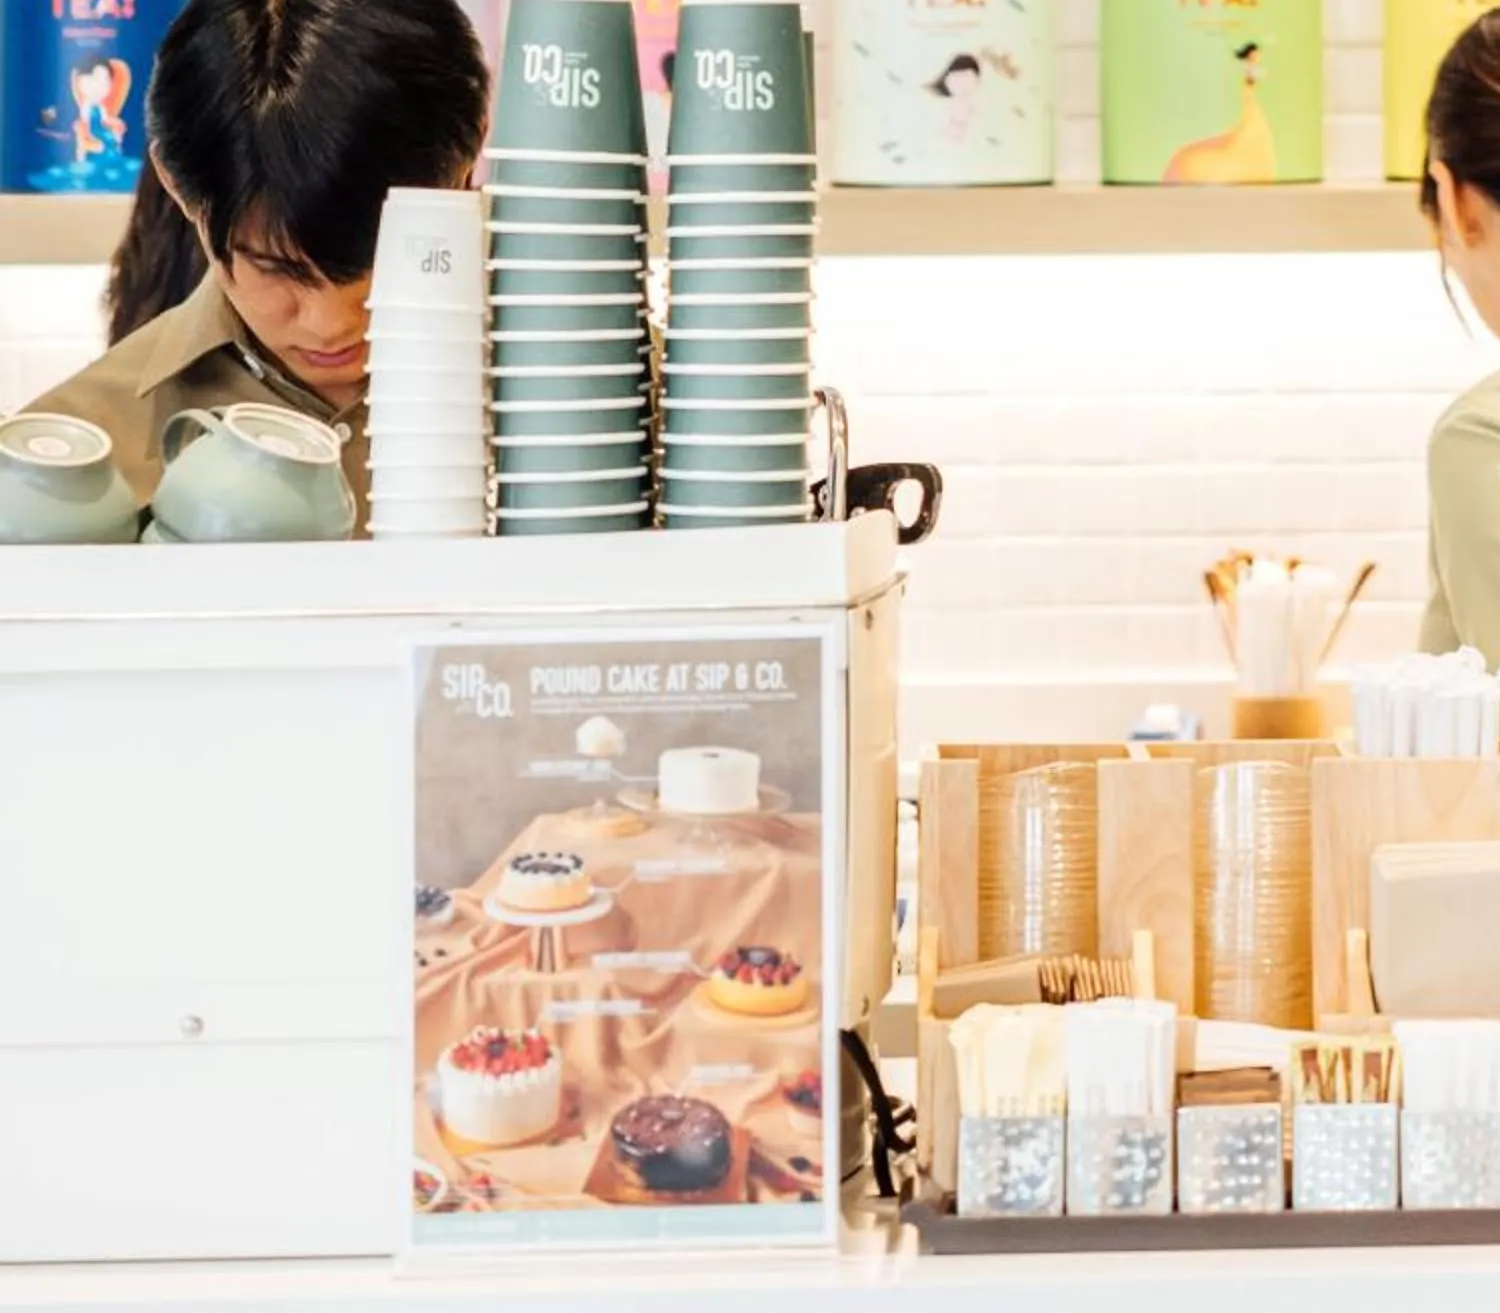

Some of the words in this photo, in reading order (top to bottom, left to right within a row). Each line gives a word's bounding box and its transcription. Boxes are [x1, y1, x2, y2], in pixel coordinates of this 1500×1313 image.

[550, 67, 601, 108] SIP
[723, 70, 775, 111] SIP
[420, 249, 453, 275] SIP
[441, 662, 486, 699] SIP
[530, 664, 602, 695] POUND
[607, 663, 661, 693] CAKE
[666, 662, 690, 692] AT
[695, 661, 730, 691] SIP
